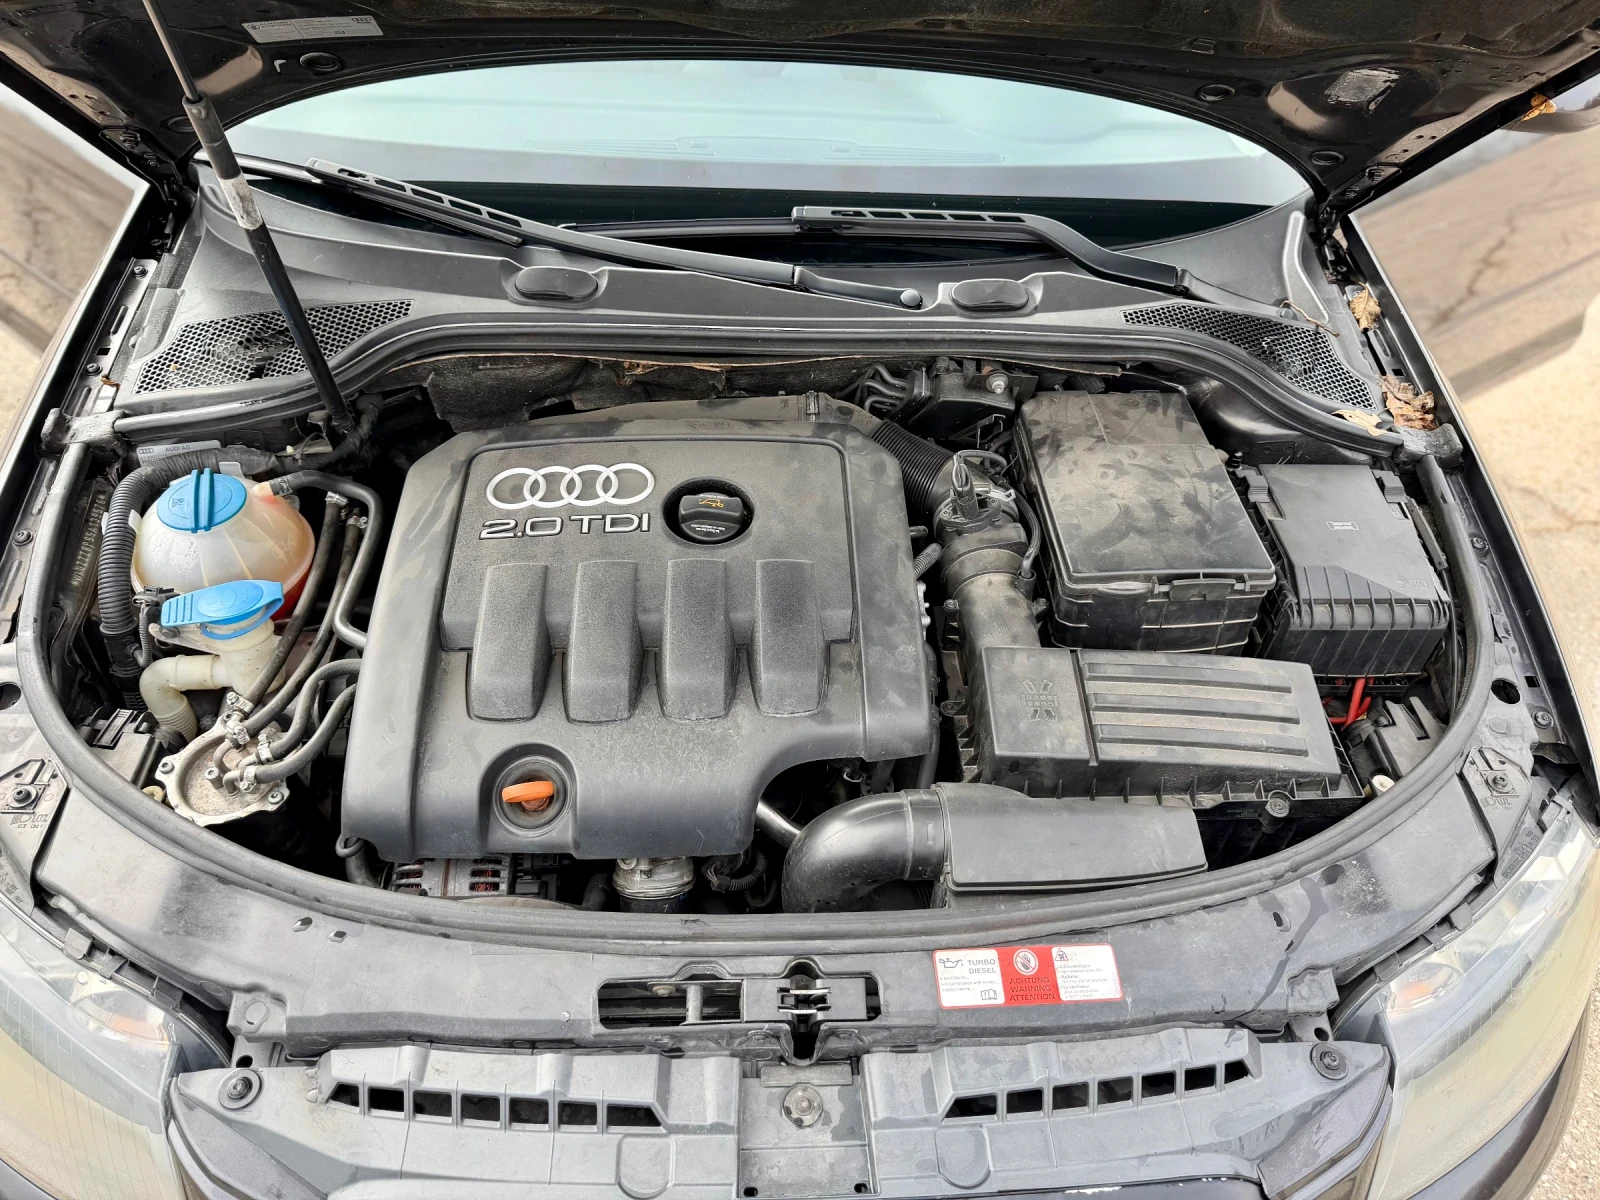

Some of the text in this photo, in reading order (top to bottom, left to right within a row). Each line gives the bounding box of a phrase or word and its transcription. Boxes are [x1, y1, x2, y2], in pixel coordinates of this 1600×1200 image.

[479, 512, 651, 540] 2.0 TDI
[967, 958, 996, 966] TURBO
[1009, 976, 1050, 985] ACHTUNG
[1010, 984, 1052, 993] WARNING
[1009, 993, 1056, 1002] ATTENTION
